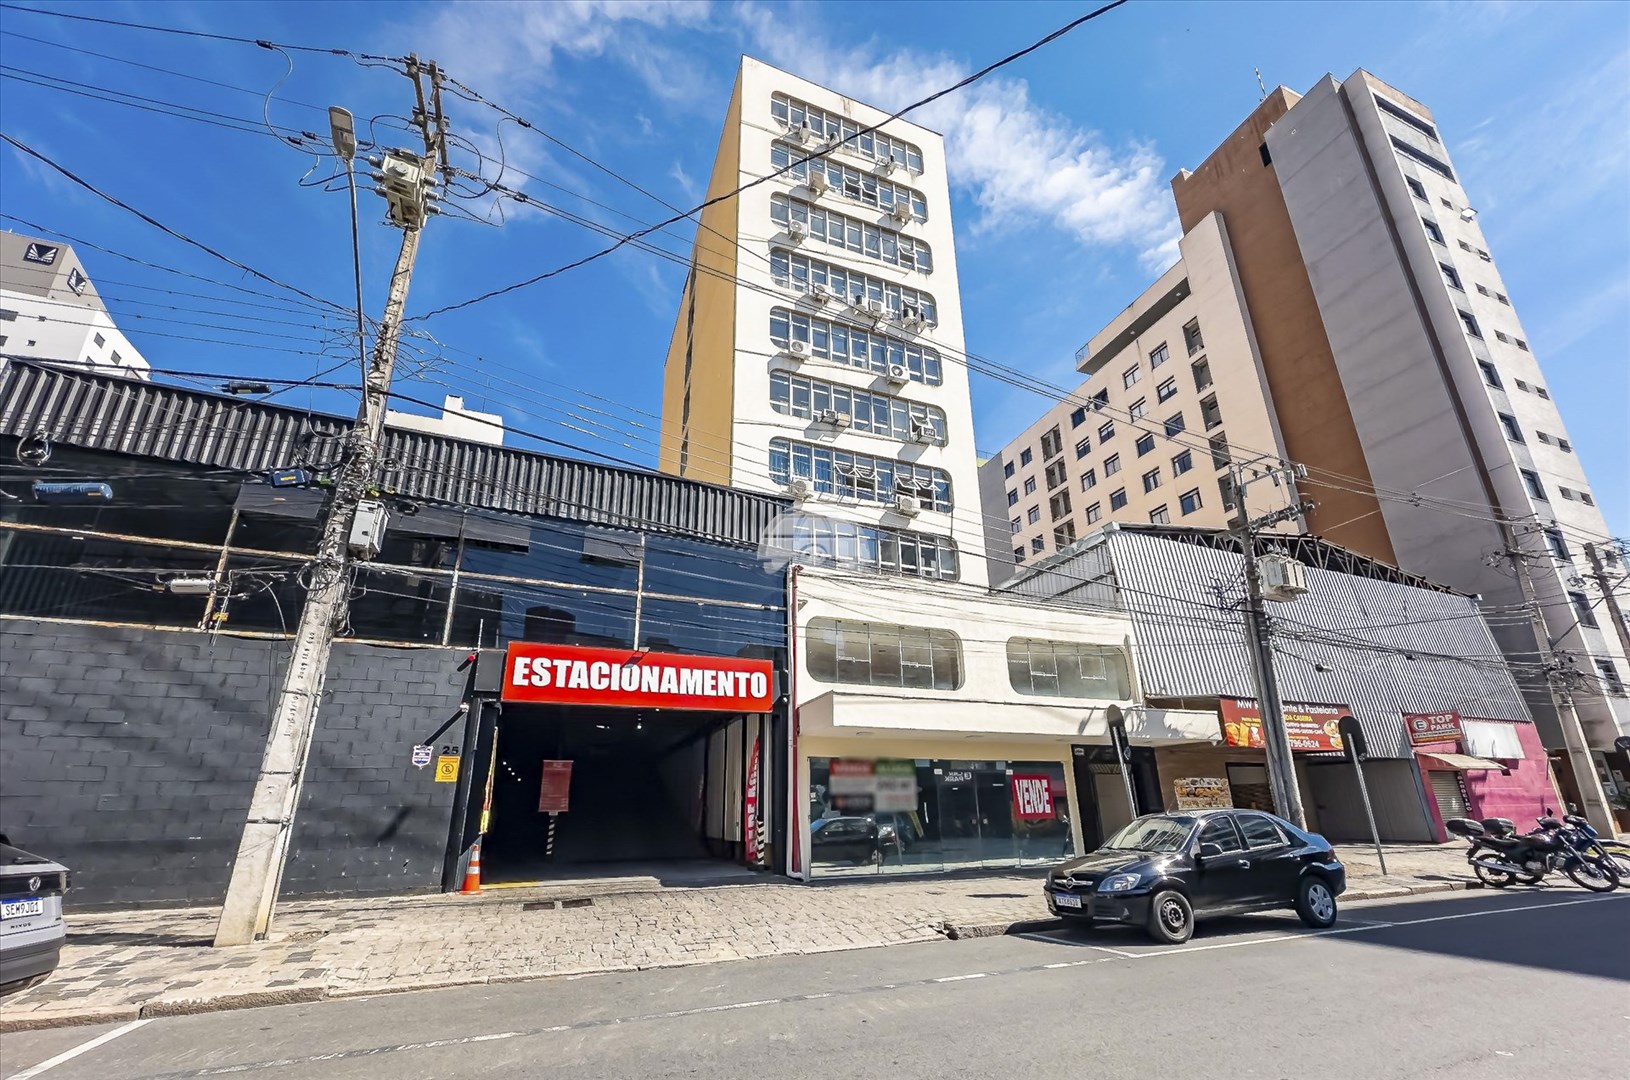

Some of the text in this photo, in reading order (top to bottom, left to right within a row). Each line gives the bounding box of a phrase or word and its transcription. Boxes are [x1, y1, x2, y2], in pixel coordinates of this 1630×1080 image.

[513, 656, 768, 698] ESTACIONAMENTO
[1237, 700, 1252, 709] MW
[1306, 704, 1338, 714] Pastelaria
[1428, 714, 1453, 723] TOP
[1430, 723, 1455, 731] PARK
[1413, 729, 1460, 738] ESTACIONAMENTO
[1289, 740, 1320, 748] 796-0624
[442, 746, 459, 755] 25
[1014, 779, 1052, 814] VENDE
